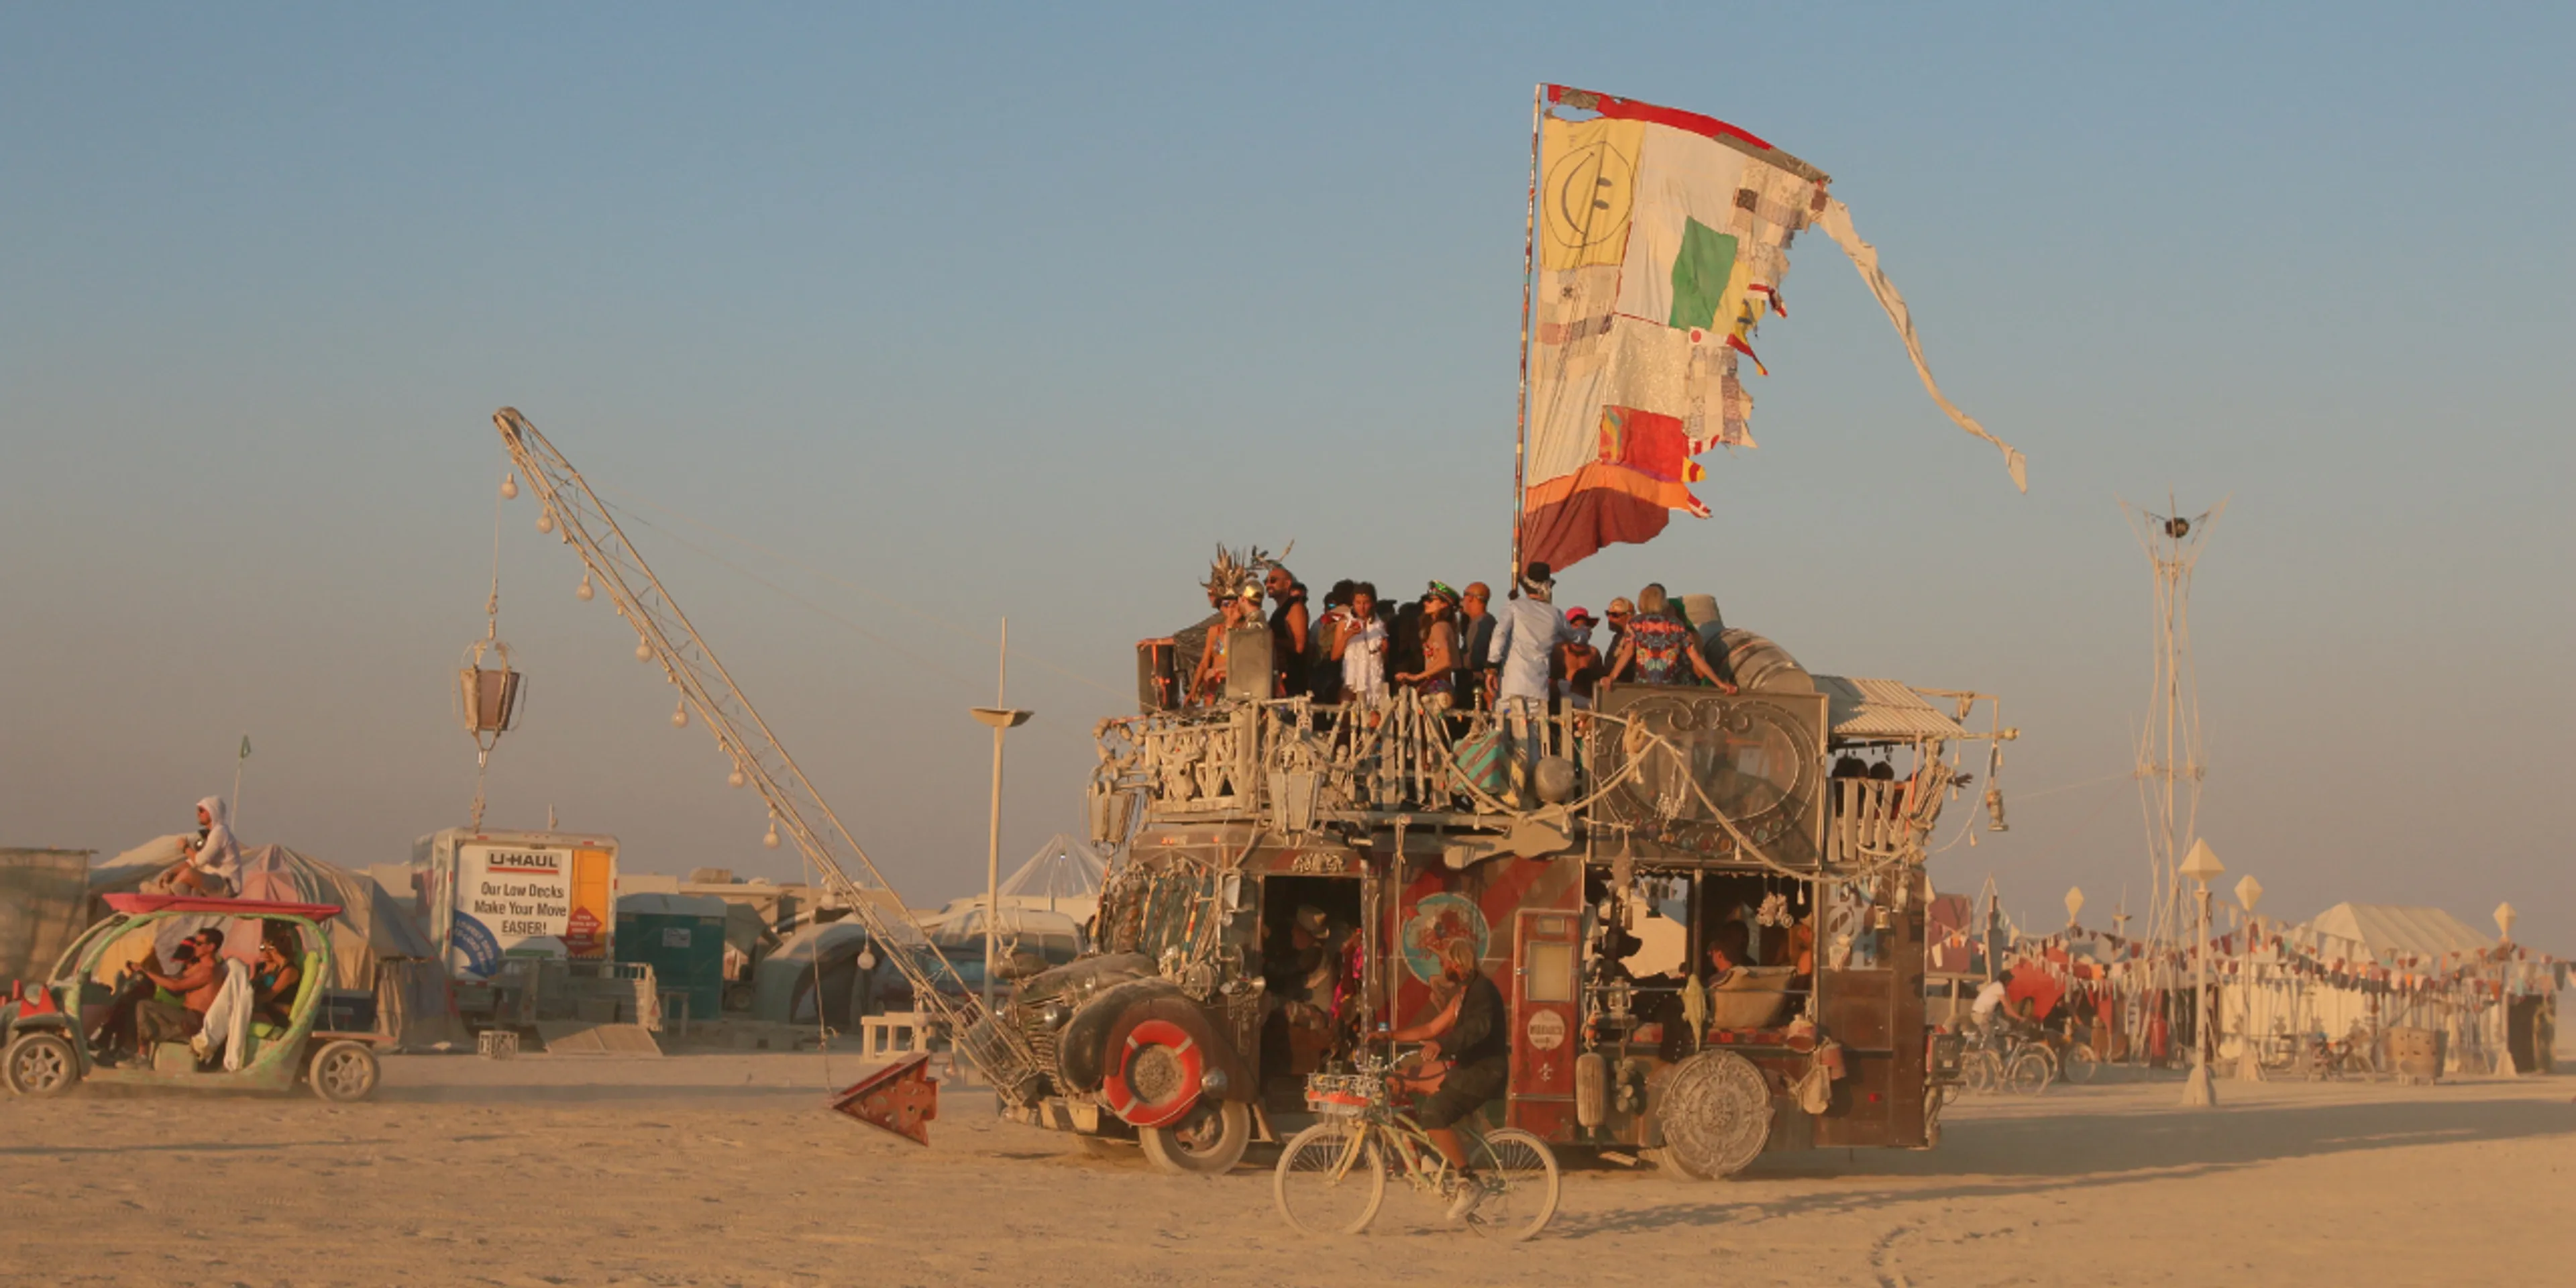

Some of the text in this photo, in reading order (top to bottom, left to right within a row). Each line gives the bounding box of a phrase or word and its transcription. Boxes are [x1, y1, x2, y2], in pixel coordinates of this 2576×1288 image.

[490, 853, 557, 867] U-HAUL
[481, 881, 564, 898] Our Low Decks
[474, 900, 566, 916] Make Your Move
[502, 920, 547, 935] EASIER!
